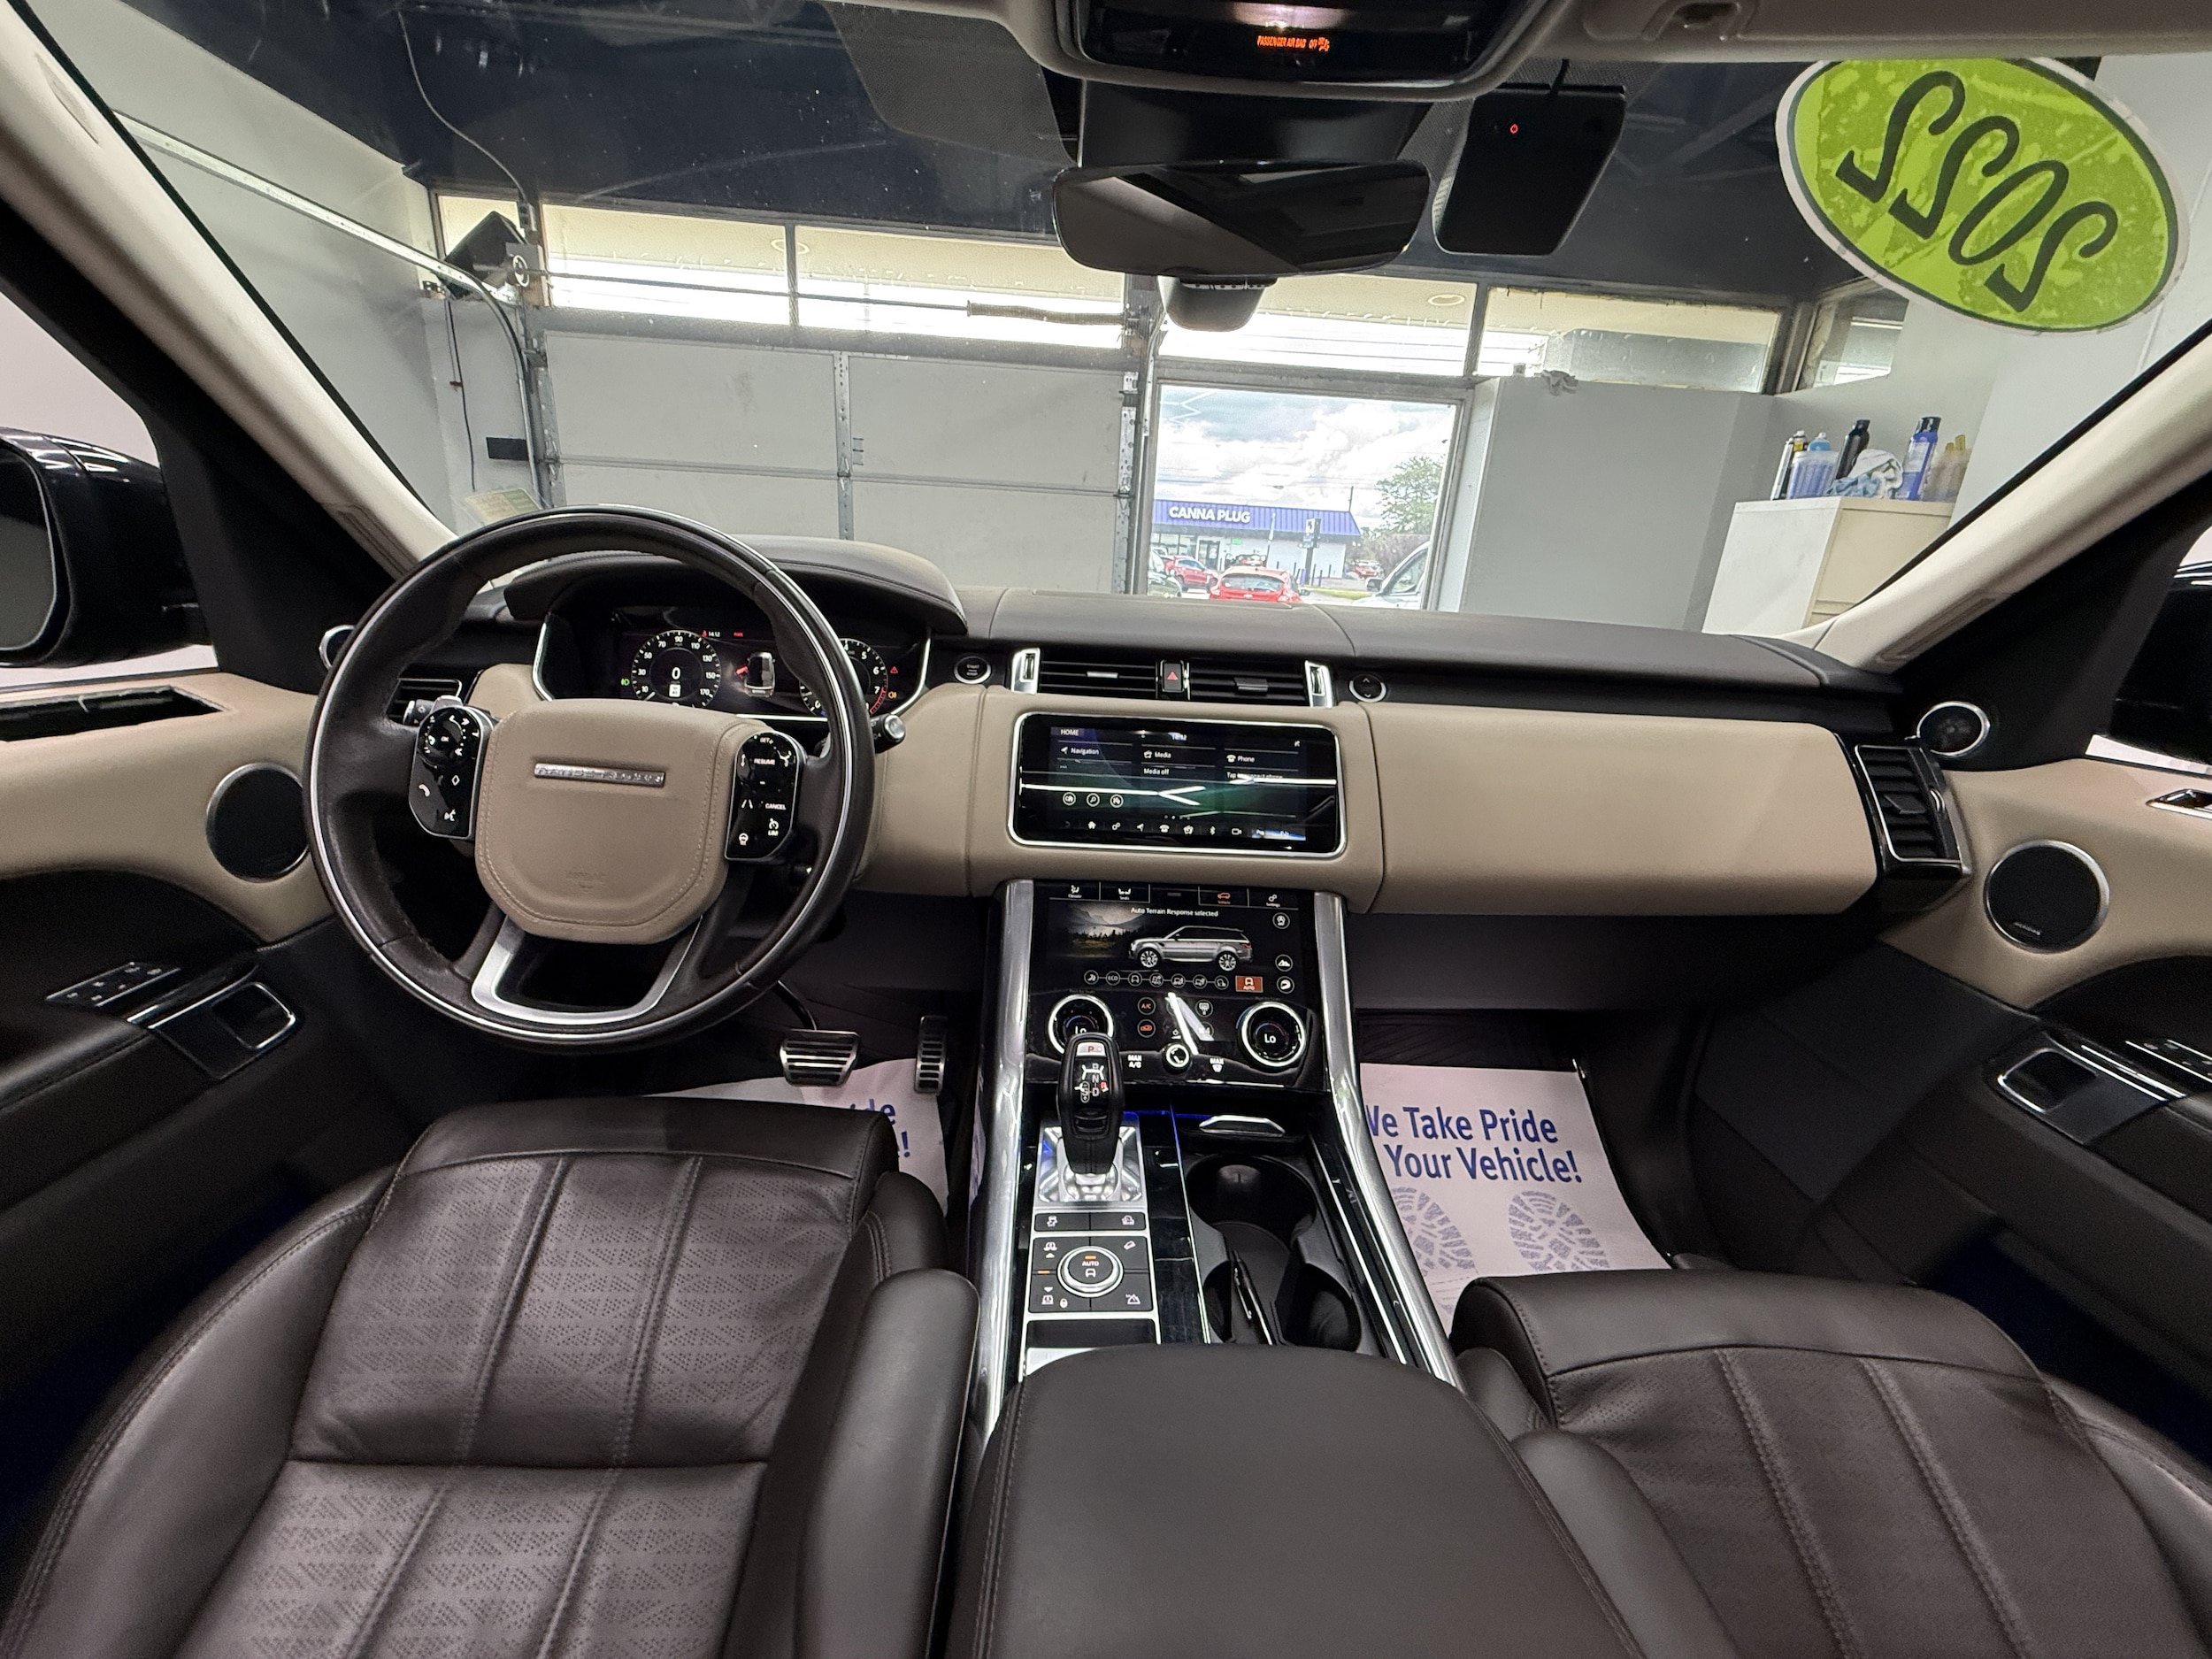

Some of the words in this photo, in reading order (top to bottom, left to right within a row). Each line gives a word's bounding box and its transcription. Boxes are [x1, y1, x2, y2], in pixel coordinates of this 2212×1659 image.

[1257, 35, 1286, 47] PASSENGER
[1169, 506, 1216, 521] CANNA
[1216, 509, 1251, 523] PLUG
[672, 667, 681, 680] 0
[1264, 1033, 1276, 1044] Lo
[1092, 1088, 1099, 1097] D
[1403, 1106, 1473, 1141] Take
[1479, 1108, 1558, 1143] Pride
[1384, 1144, 1452, 1179] Your
[1455, 1147, 1582, 1183] Vehicle!
